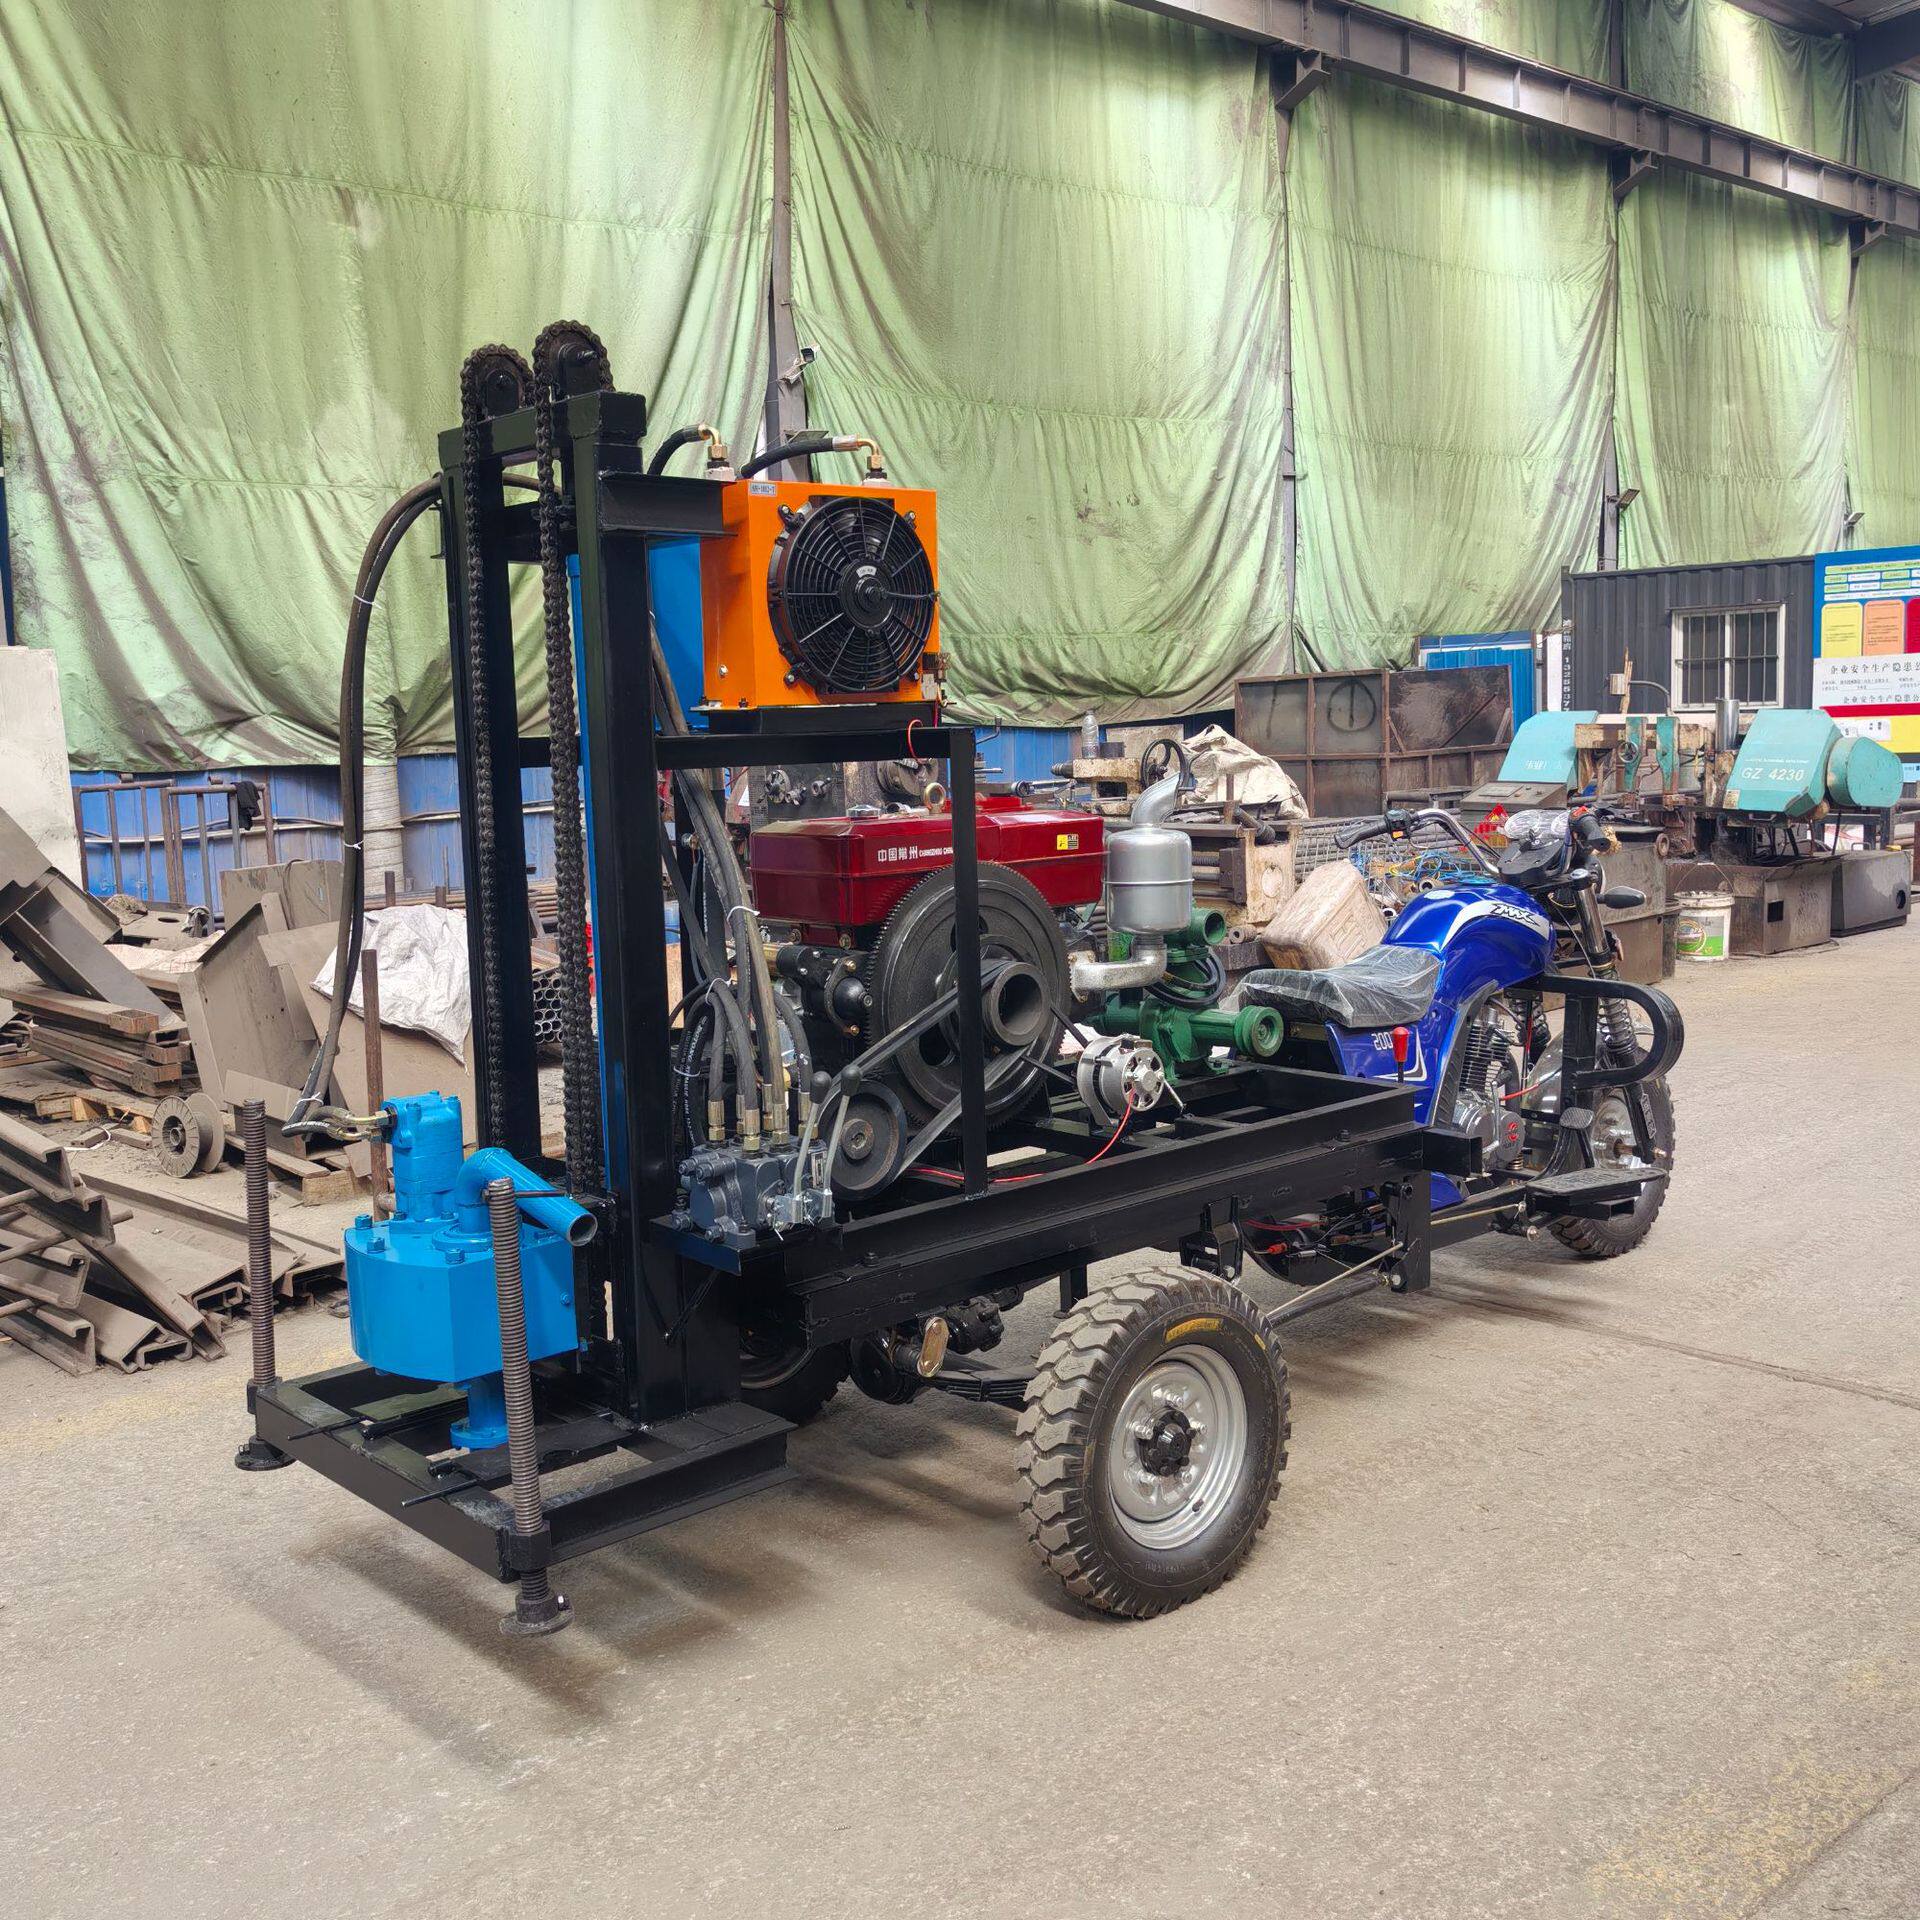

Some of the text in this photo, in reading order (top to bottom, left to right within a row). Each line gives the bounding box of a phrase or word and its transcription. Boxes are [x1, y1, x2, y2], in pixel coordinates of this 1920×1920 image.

[1741, 767, 1804, 781] GZ 4230
[877, 845, 918, 862] 中国常州
[1371, 1031, 1393, 1050] 200
